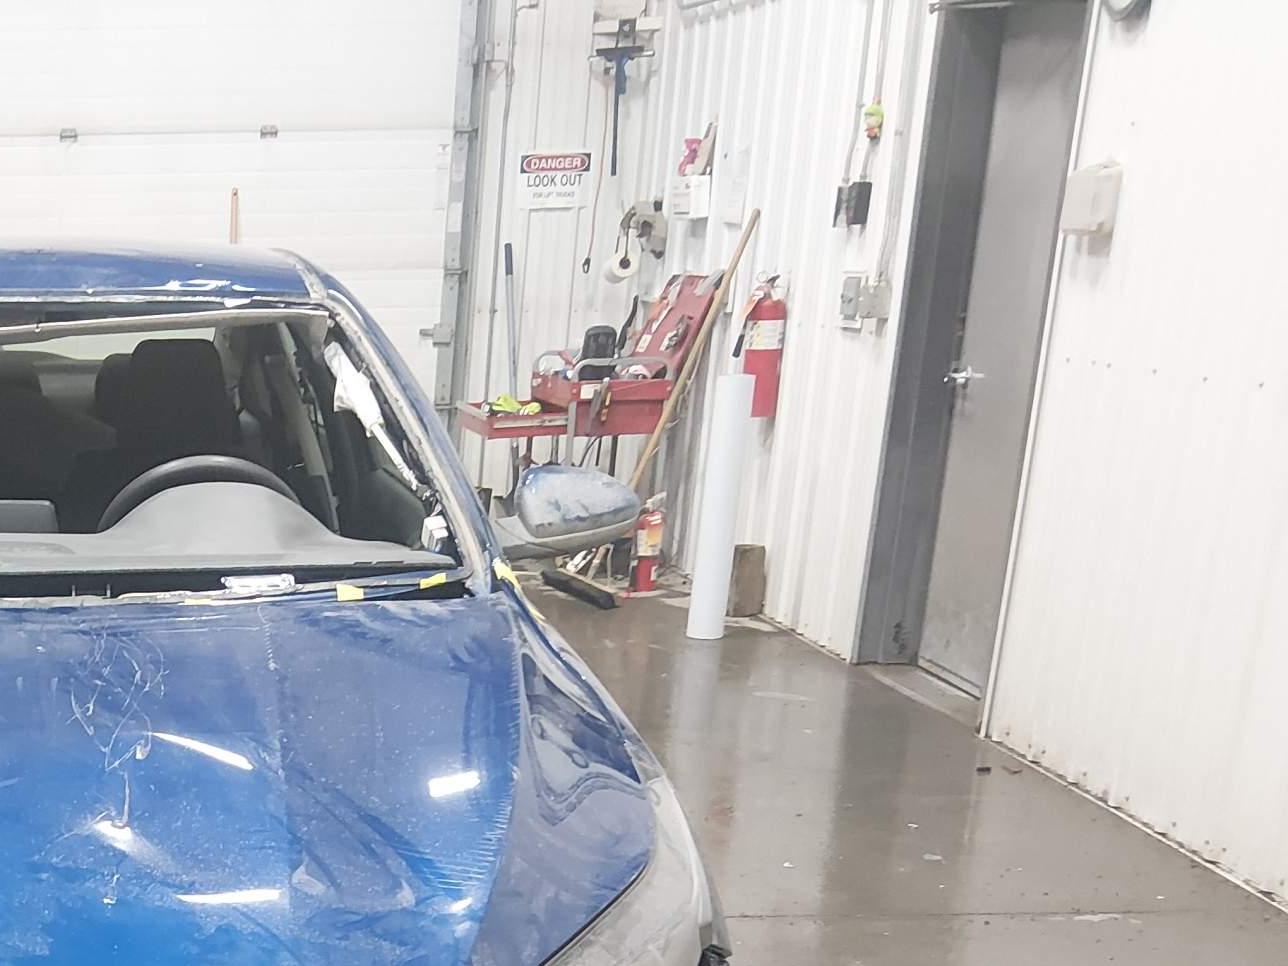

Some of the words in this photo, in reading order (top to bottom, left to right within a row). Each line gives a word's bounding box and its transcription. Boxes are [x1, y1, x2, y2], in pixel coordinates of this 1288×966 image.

[530, 157, 582, 169] DANGER
[526, 173, 557, 188] LOOK
[560, 173, 584, 187] OUT
